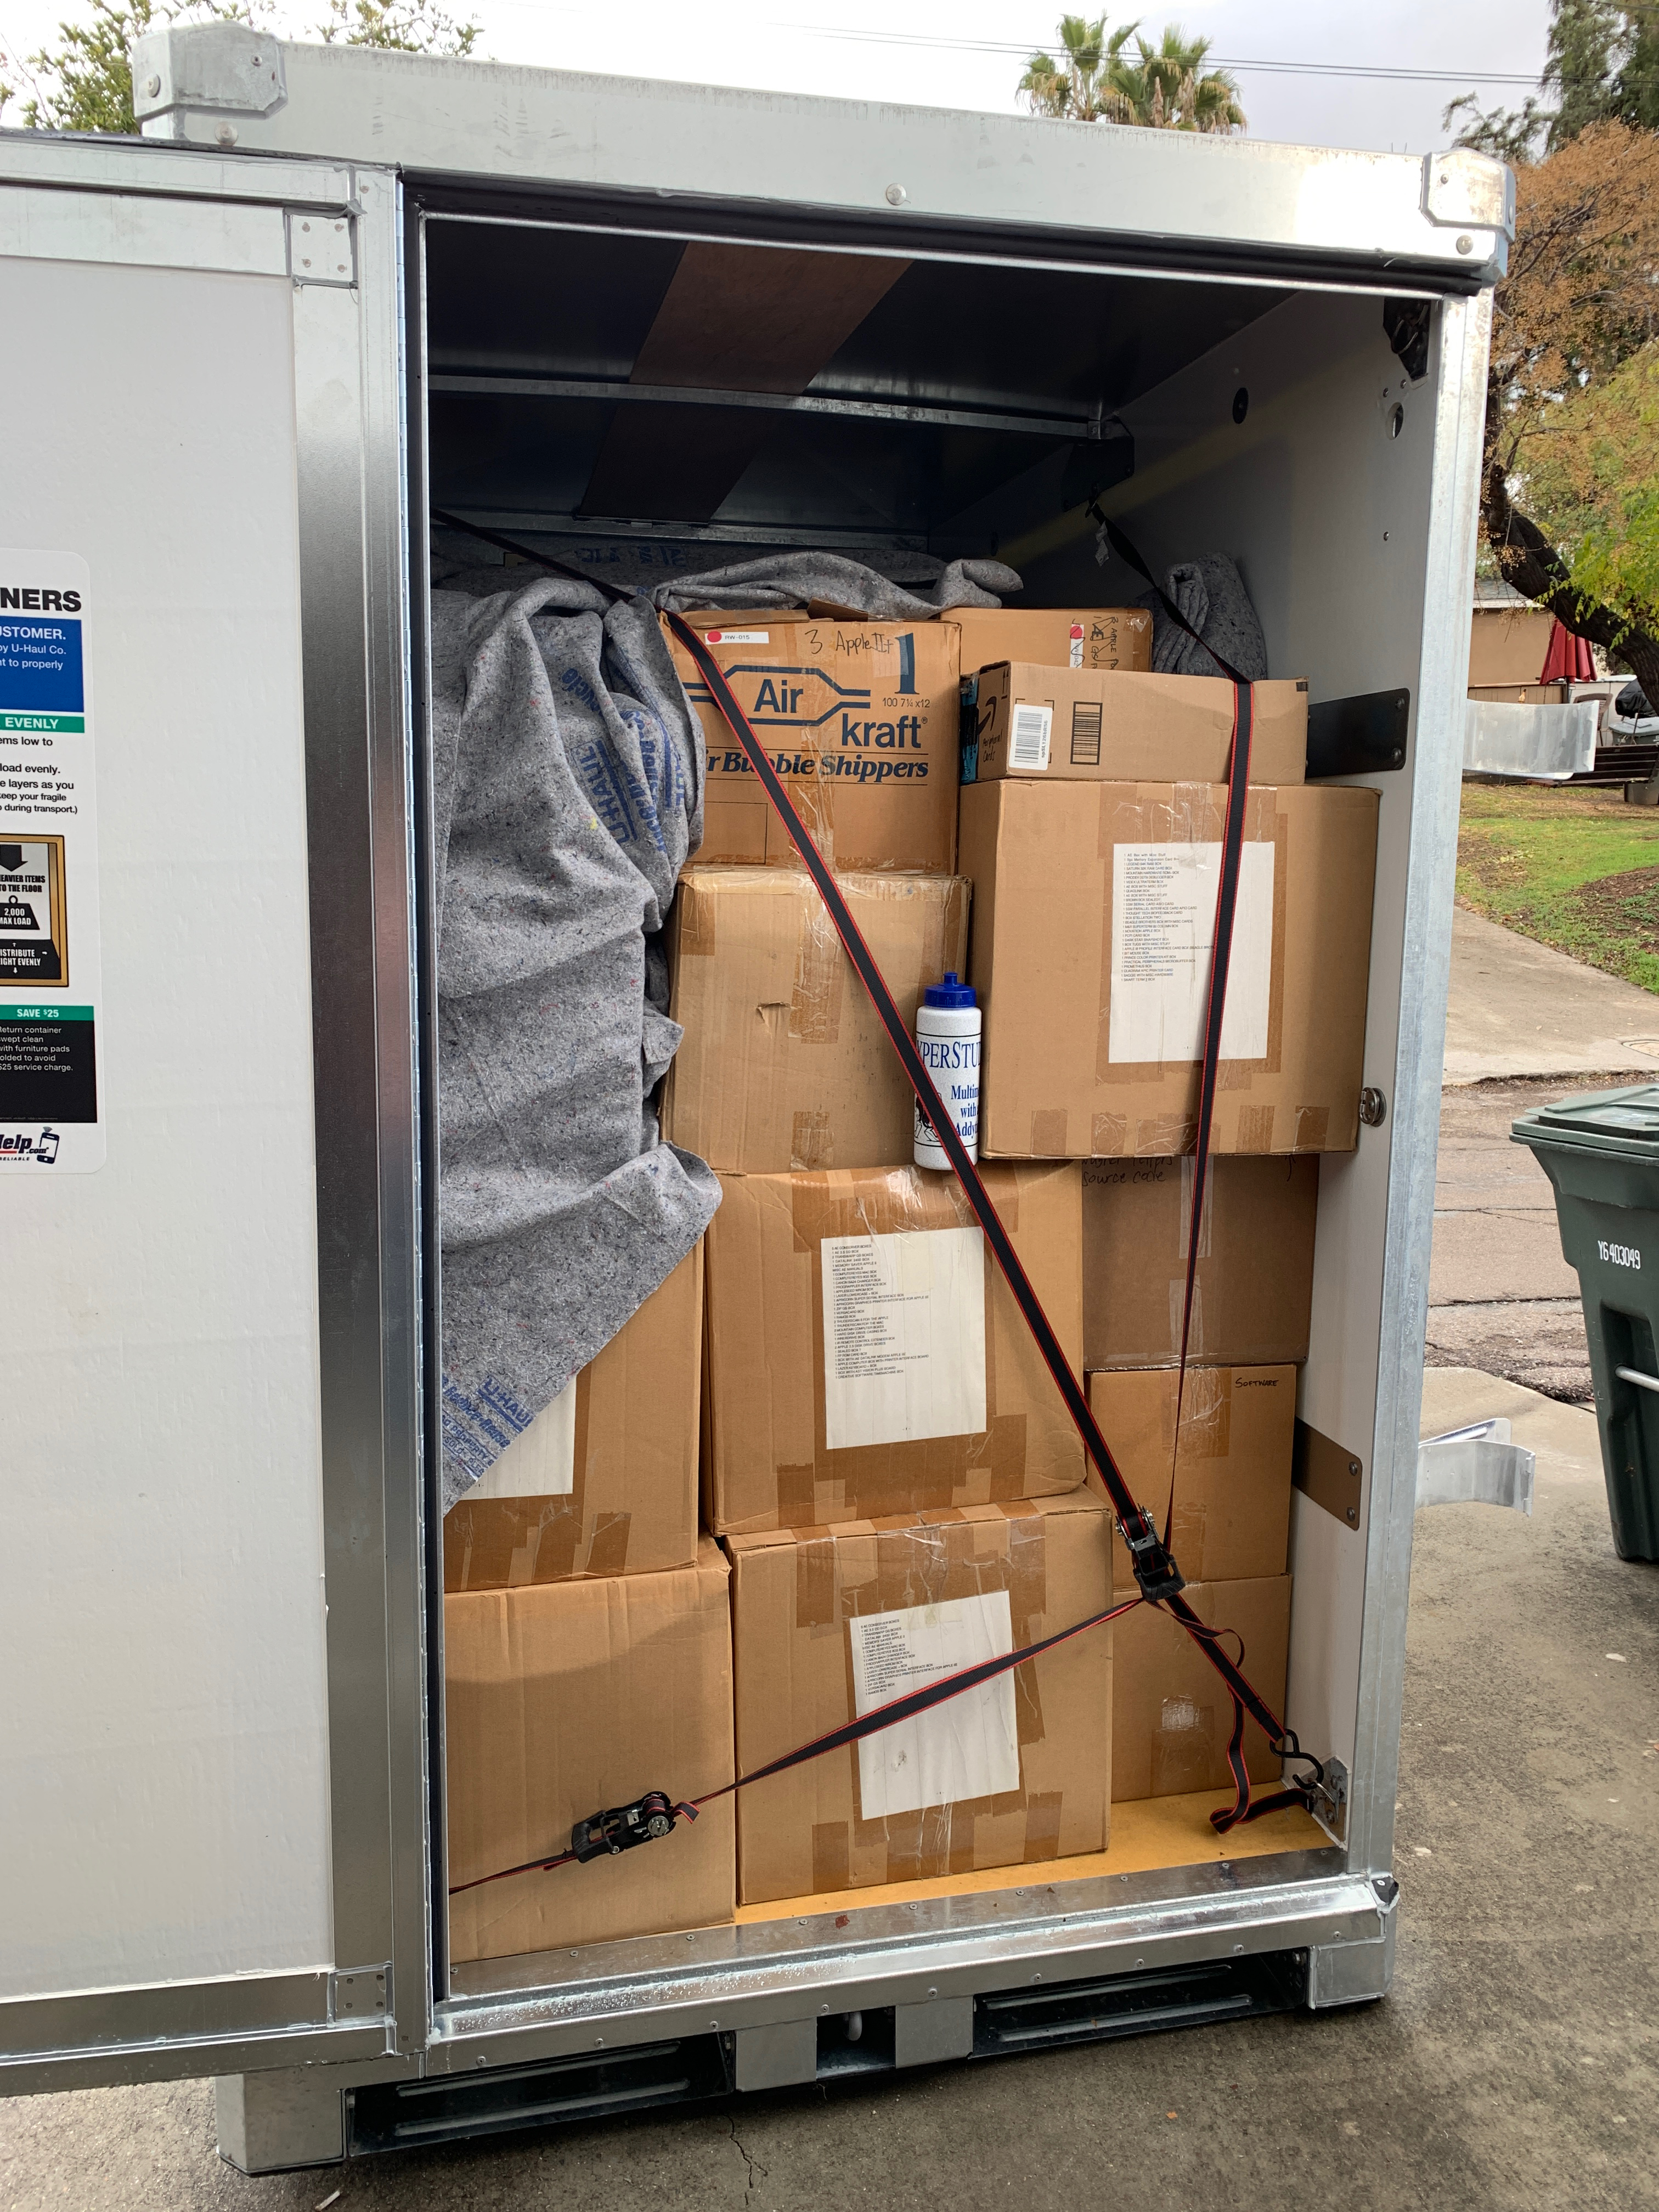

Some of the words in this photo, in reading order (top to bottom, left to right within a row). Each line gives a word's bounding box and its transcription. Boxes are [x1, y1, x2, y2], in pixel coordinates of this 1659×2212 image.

[0, 588, 81, 612] NERS
[0, 626, 66, 640] STOMER.
[804, 629, 823, 654] 3
[11, 644, 46, 653] U-Haul
[49, 645, 66, 654] Co.
[8, 659, 19, 667] to
[22, 660, 63, 671] properly
[895, 632, 920, 695] 1
[753, 679, 804, 713] Air
[882, 697, 898, 707] 100
[915, 699, 930, 708] x12
[5, 717, 59, 729] EVENLY
[842, 713, 922, 748] kraft
[21, 737, 39, 746] low
[43, 738, 53, 746] to
[25, 765, 60, 775] evenly.
[721, 752, 814, 776] Buble
[819, 749, 928, 783] Shippers
[9, 779, 38, 789] layers
[41, 793, 66, 802] fragile
[4, 804, 31, 813] during
[34, 805, 78, 815] transport.)
[25, 875, 46, 883] ITEMS
[8, 884, 20, 893] THE
[21, 884, 42, 893] FLOOR
[4, 908, 25, 917] 2,000
[14, 917, 31, 926] LOAD
[18, 958, 41, 966] EVENLY
[16, 1008, 41, 1018] SAVE
[43, 1009, 59, 1018] $25
[917, 1040, 980, 1069] YPERSTU
[44, 1064, 74, 1073] charge.
[961, 1103, 976, 1118] with
